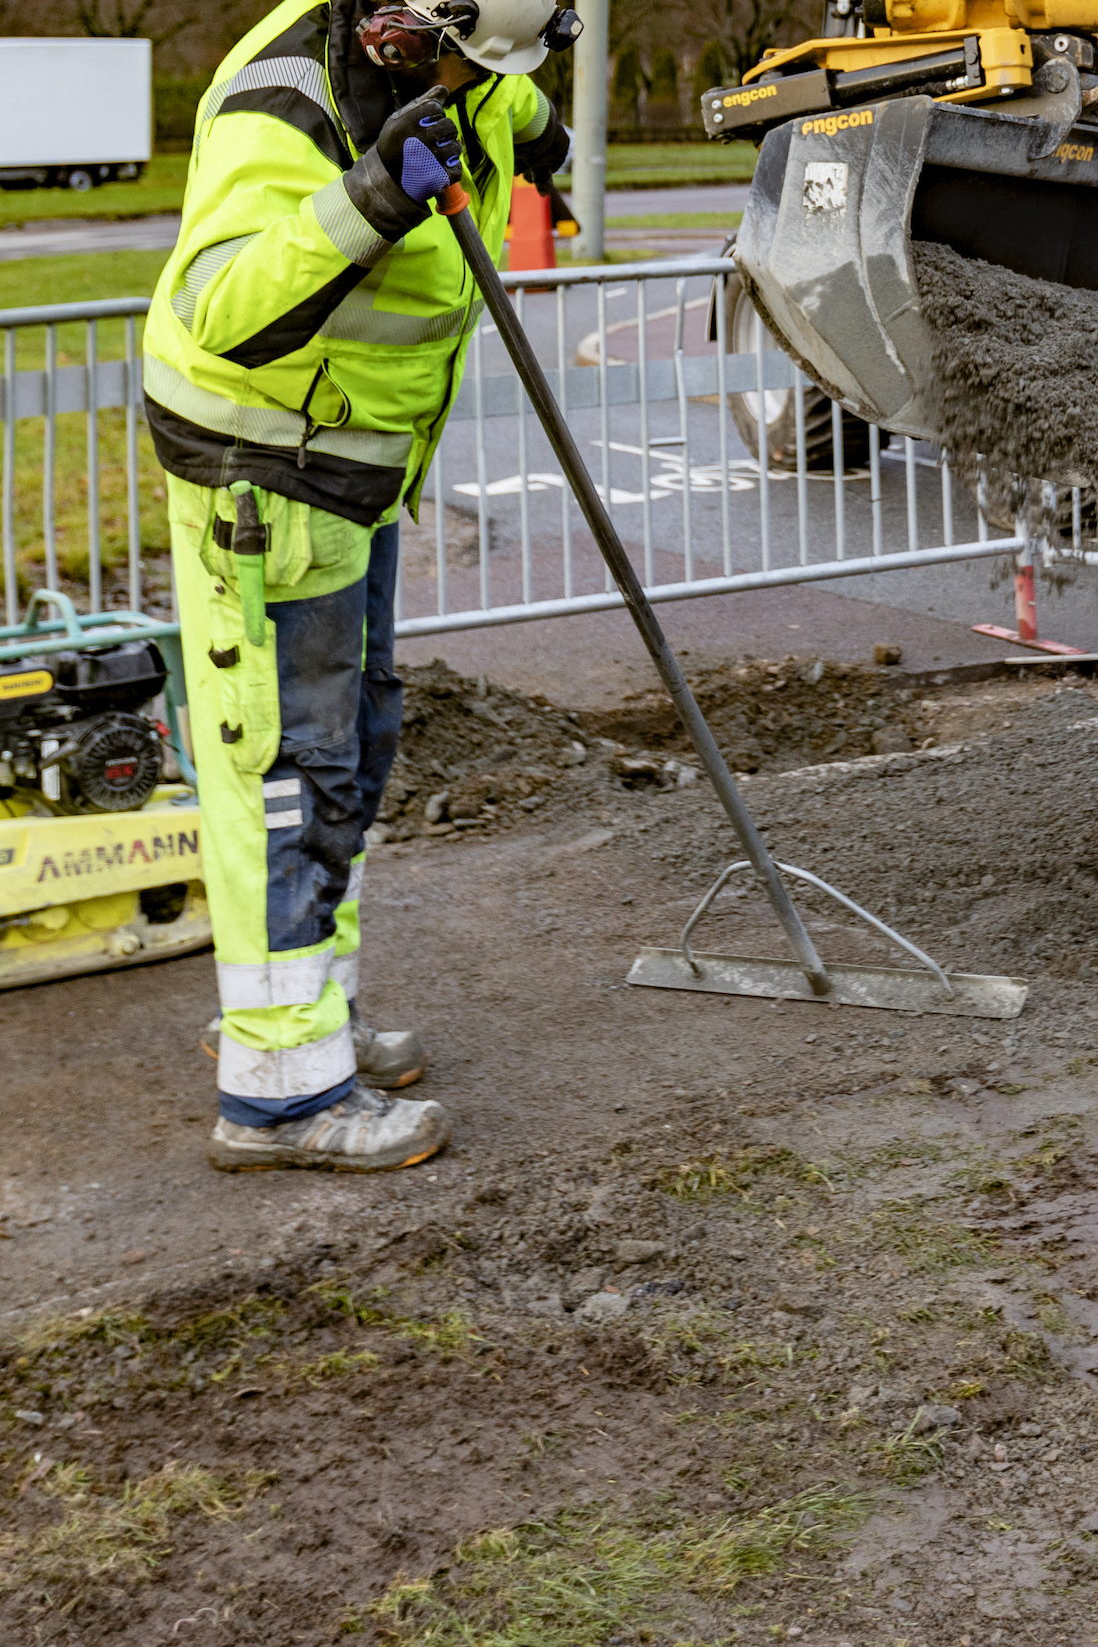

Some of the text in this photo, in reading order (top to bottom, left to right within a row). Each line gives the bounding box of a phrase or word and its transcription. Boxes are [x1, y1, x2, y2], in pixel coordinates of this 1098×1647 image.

[722, 85, 777, 108] engcon
[801, 110, 873, 136] engcon
[1053, 143, 1094, 163] gcon
[37, 829, 199, 882] AMMANN
